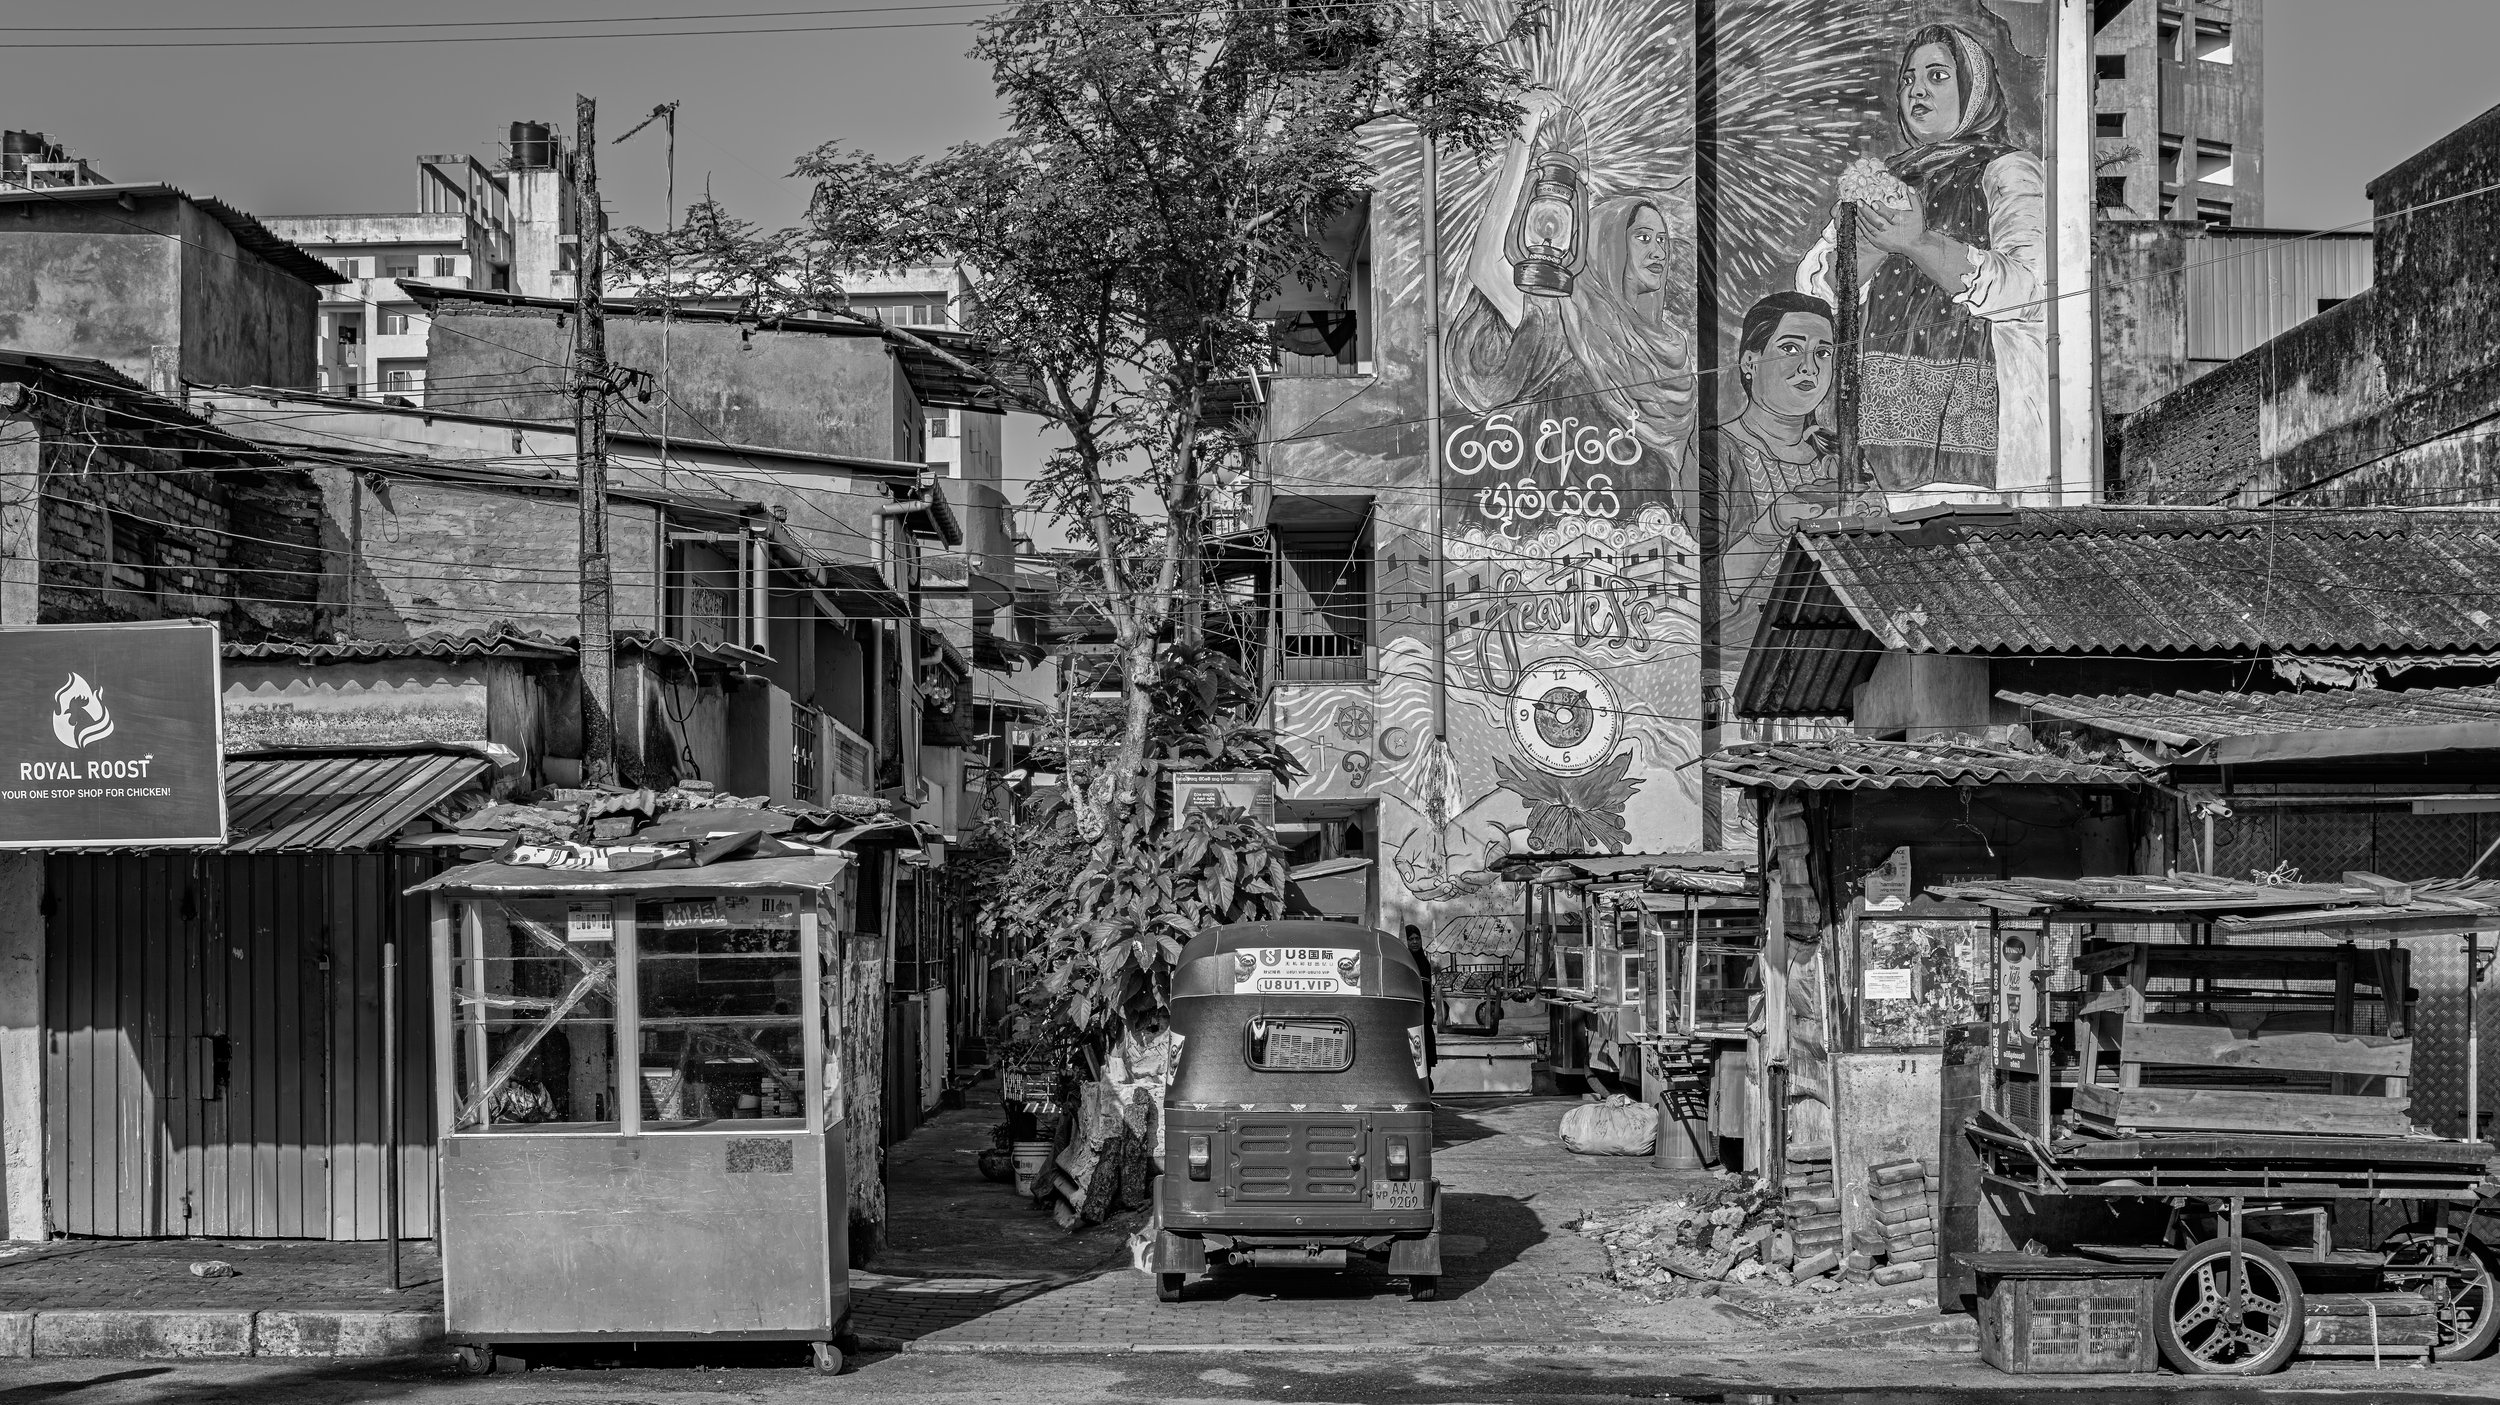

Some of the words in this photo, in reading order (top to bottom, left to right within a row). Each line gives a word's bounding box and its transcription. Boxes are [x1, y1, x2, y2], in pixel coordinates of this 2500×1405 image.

[1552, 669, 1567, 680] 12
[1519, 709, 1530, 721] 9
[1599, 707, 1608, 717] 3
[1562, 751, 1571, 763] 6
[20, 761, 82, 780] ROYAL
[87, 760, 150, 779] ROOST
[1, 789, 27, 800] YOUR
[29, 789, 49, 799] ONE
[51, 789, 75, 798] STOP
[77, 788, 103, 798] SHOP
[105, 788, 124, 797] FOR
[126, 787, 171, 797] CHICKEN!
[1263, 980, 1332, 990] U8U1.VIP
[1392, 1182, 1417, 1195] AAV
[1376, 1190, 1388, 1200] WP
[1390, 1196, 1418, 1208] 9209
